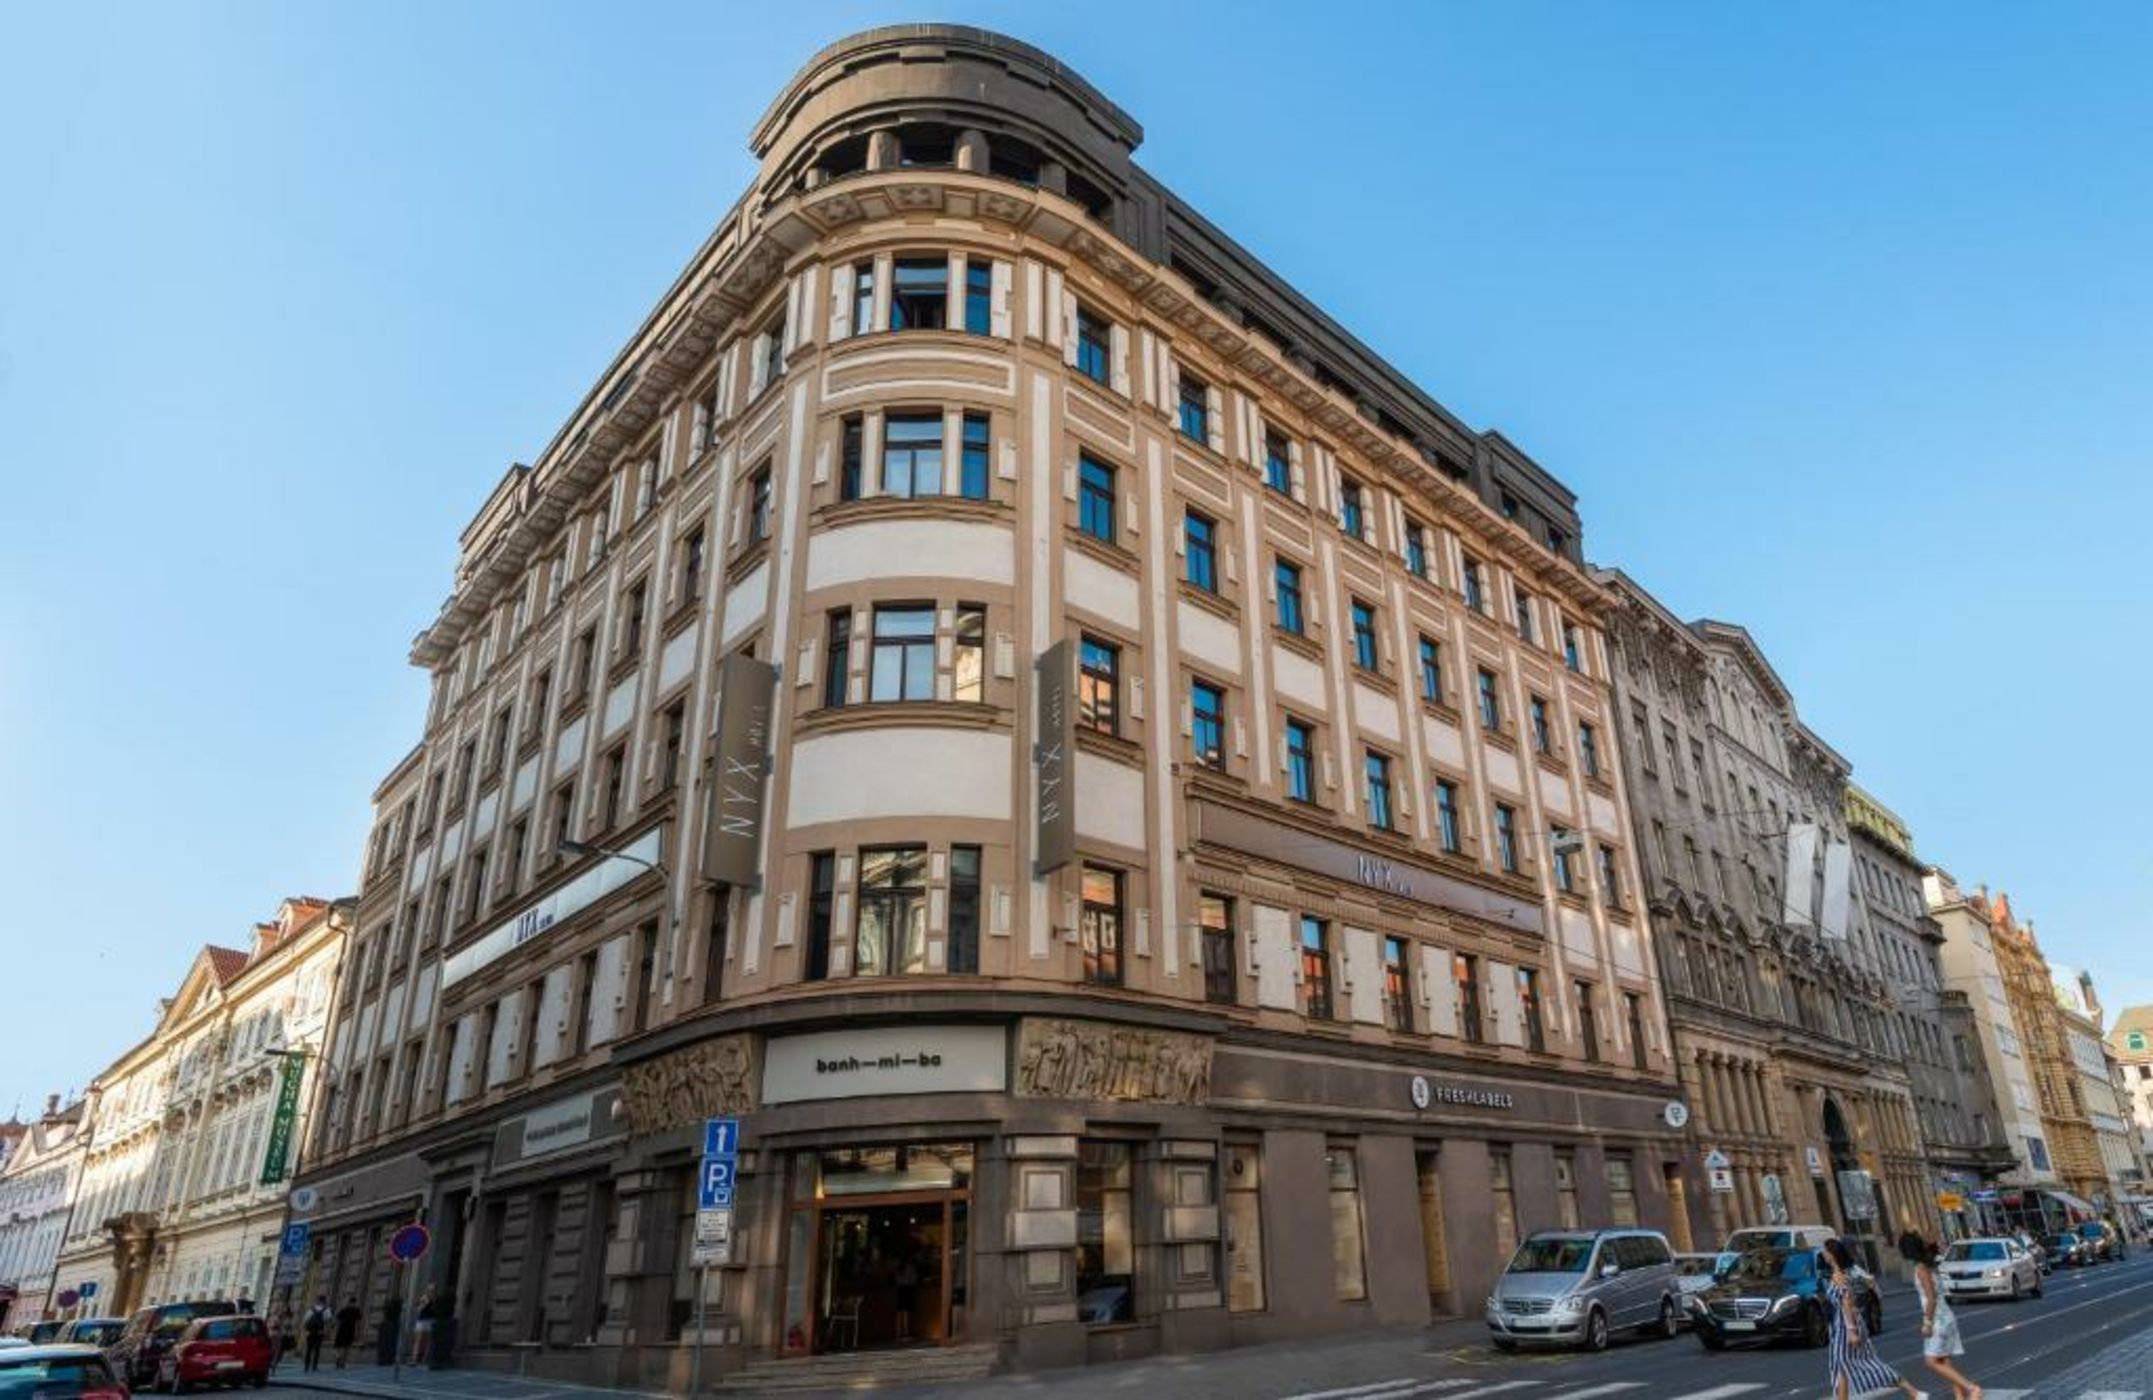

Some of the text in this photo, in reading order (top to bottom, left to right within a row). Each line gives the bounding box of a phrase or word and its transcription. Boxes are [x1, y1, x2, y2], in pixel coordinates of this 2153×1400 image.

[719, 756, 759, 837] NYX
[1042, 743, 1061, 823] NYX
[282, 1058, 303, 1110] MUCHA
[707, 1163, 728, 1193] P
